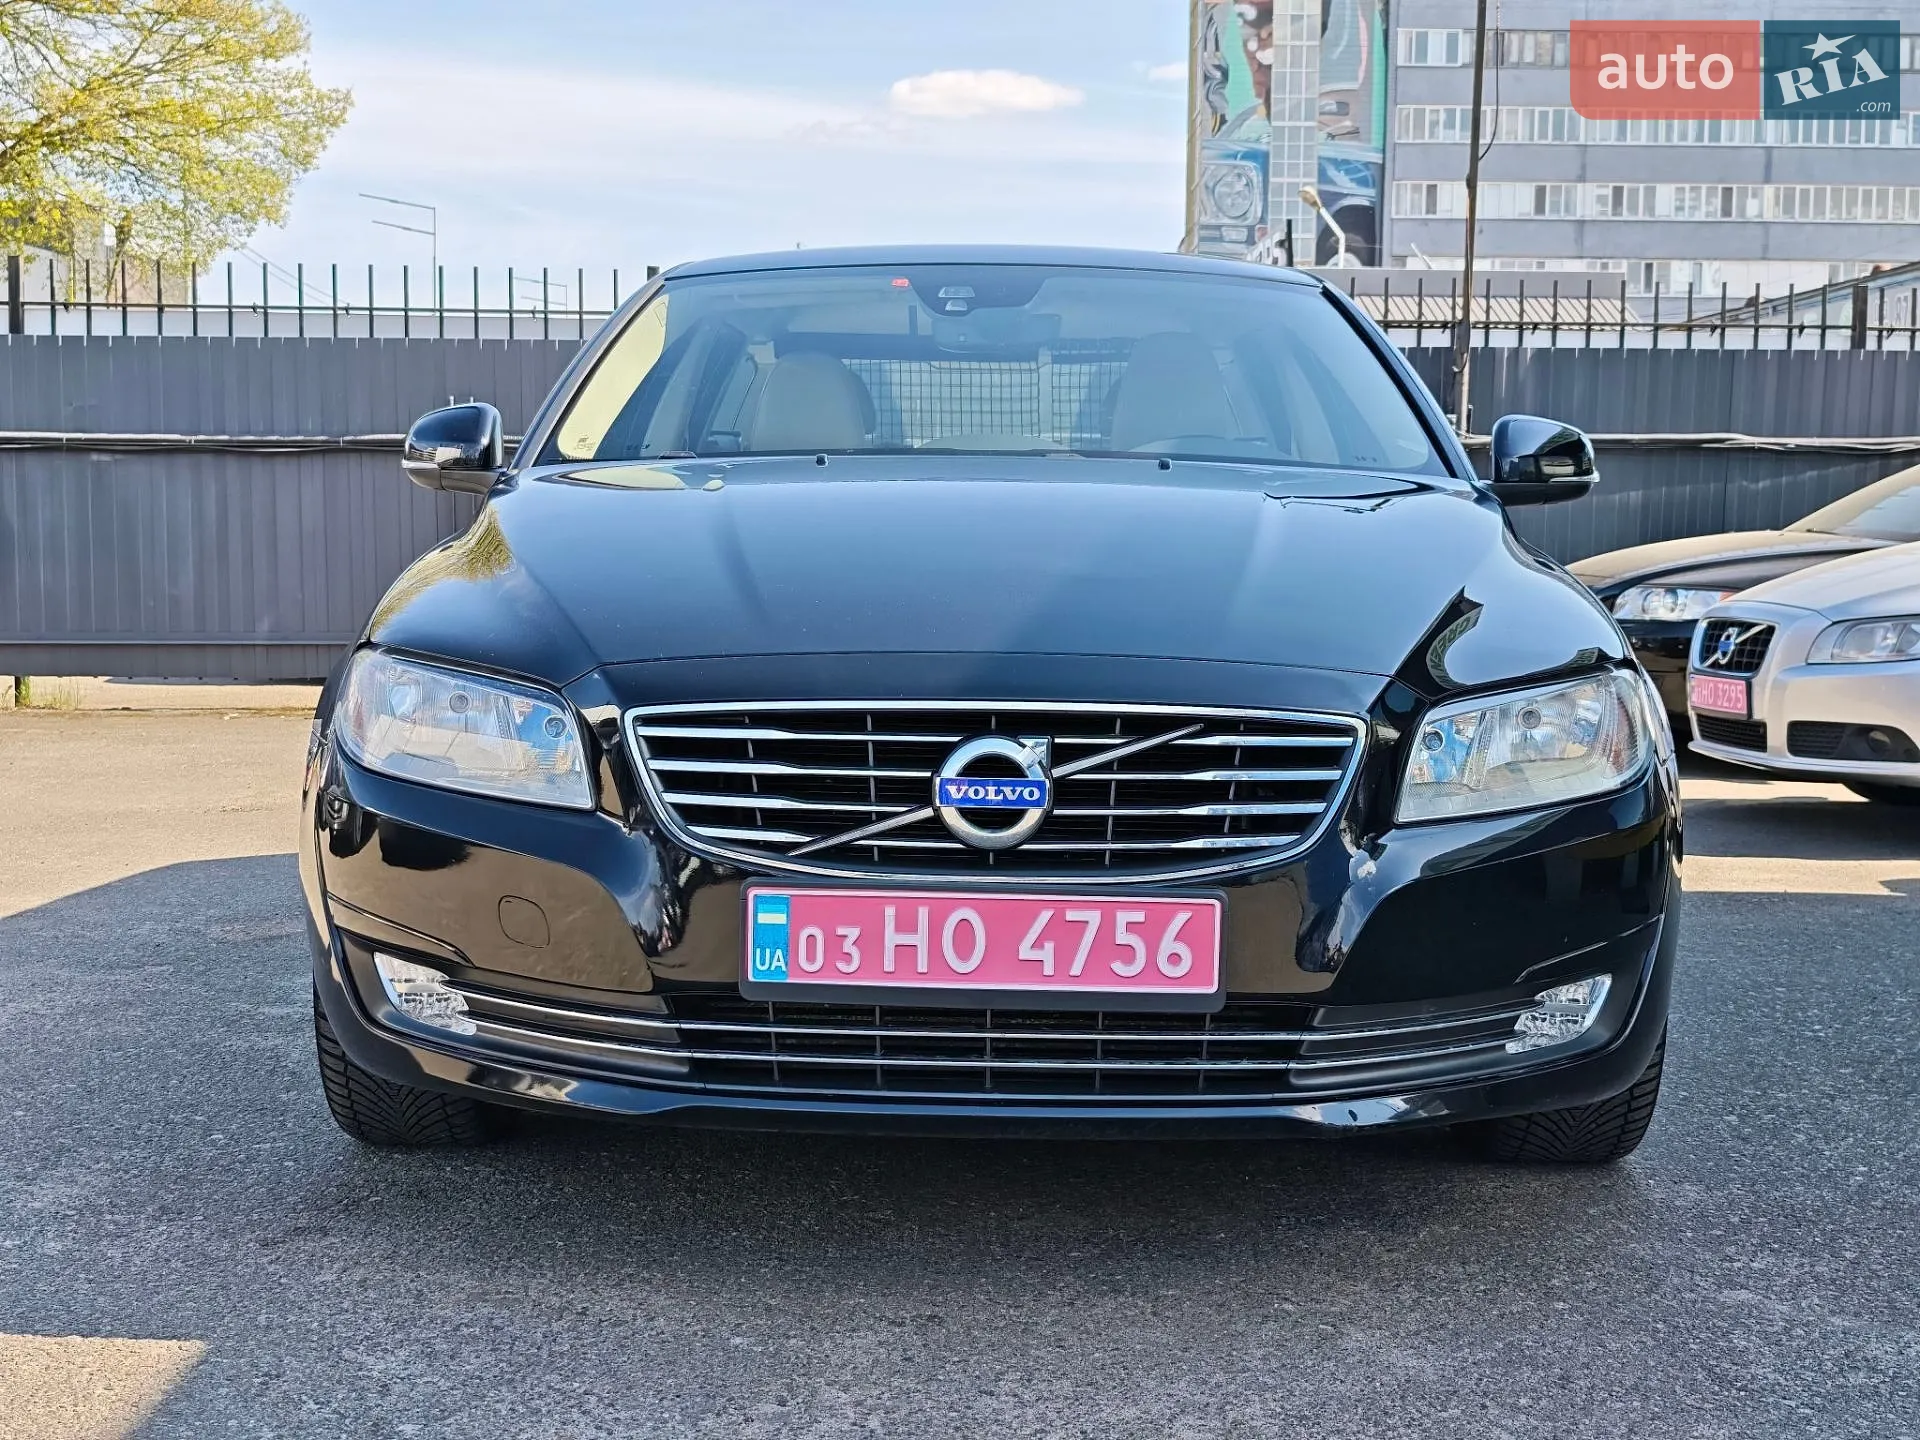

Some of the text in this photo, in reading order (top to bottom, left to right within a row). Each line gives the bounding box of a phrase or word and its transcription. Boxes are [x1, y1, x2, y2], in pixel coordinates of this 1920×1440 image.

[1717, 682, 1744, 710] 3295
[946, 786, 1041, 801] VOLVO
[797, 906, 1193, 979] 03 HO 4756
[756, 948, 787, 972] UA
